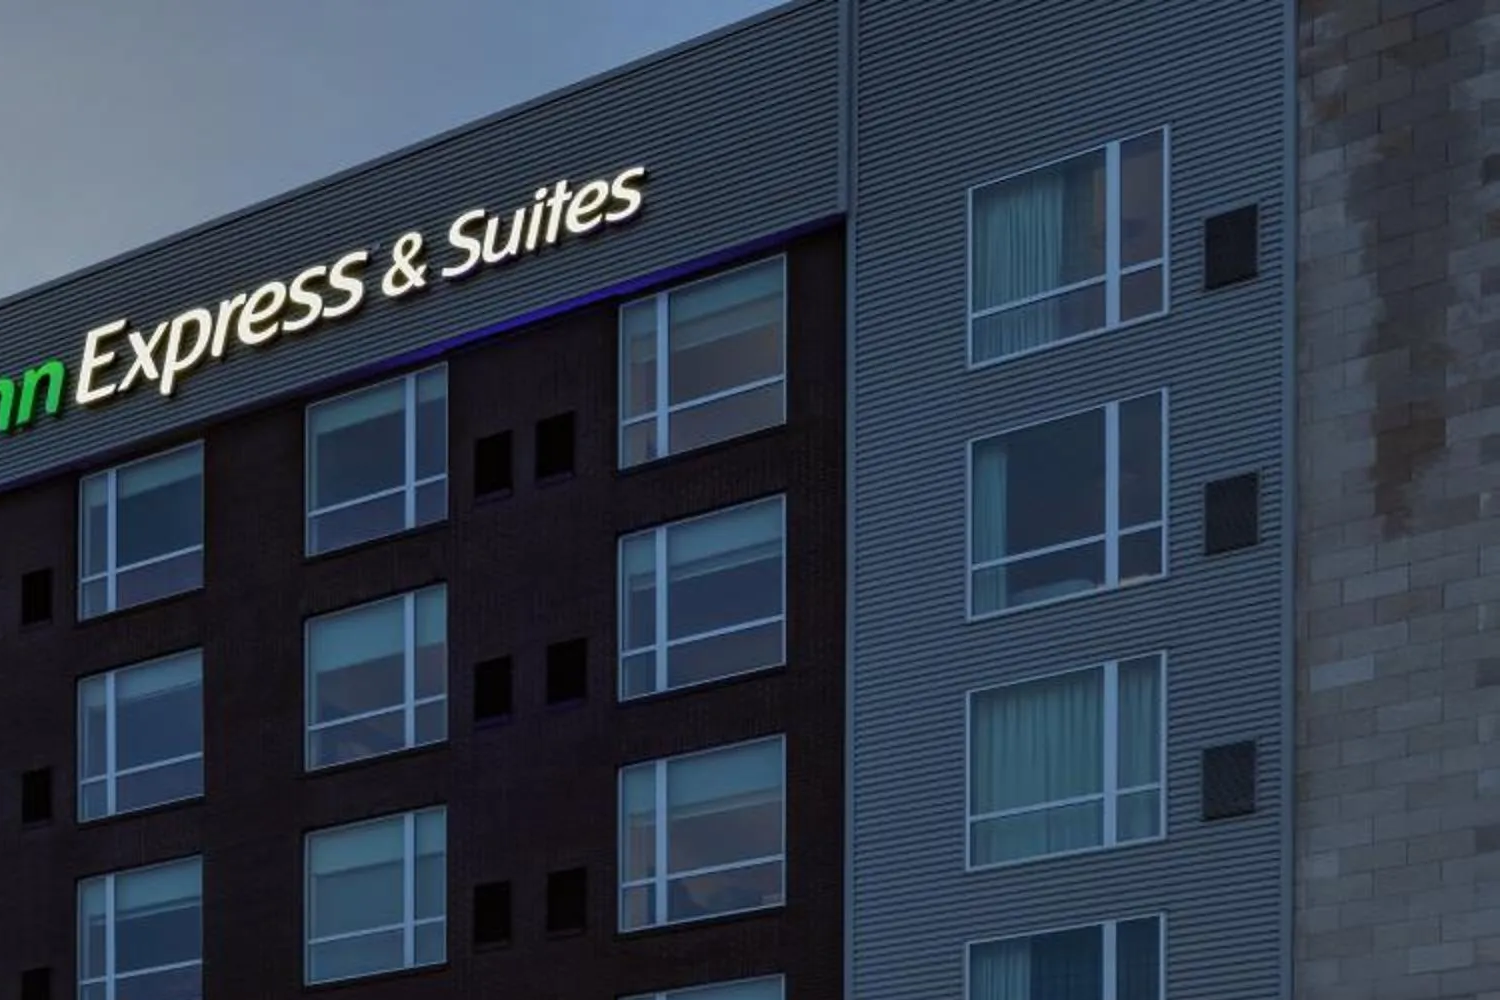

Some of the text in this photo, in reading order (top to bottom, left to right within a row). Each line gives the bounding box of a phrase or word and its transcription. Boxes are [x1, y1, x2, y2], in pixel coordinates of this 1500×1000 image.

[74, 250, 366, 404] Express
[381, 232, 428, 299] &
[440, 165, 645, 281] Suites
